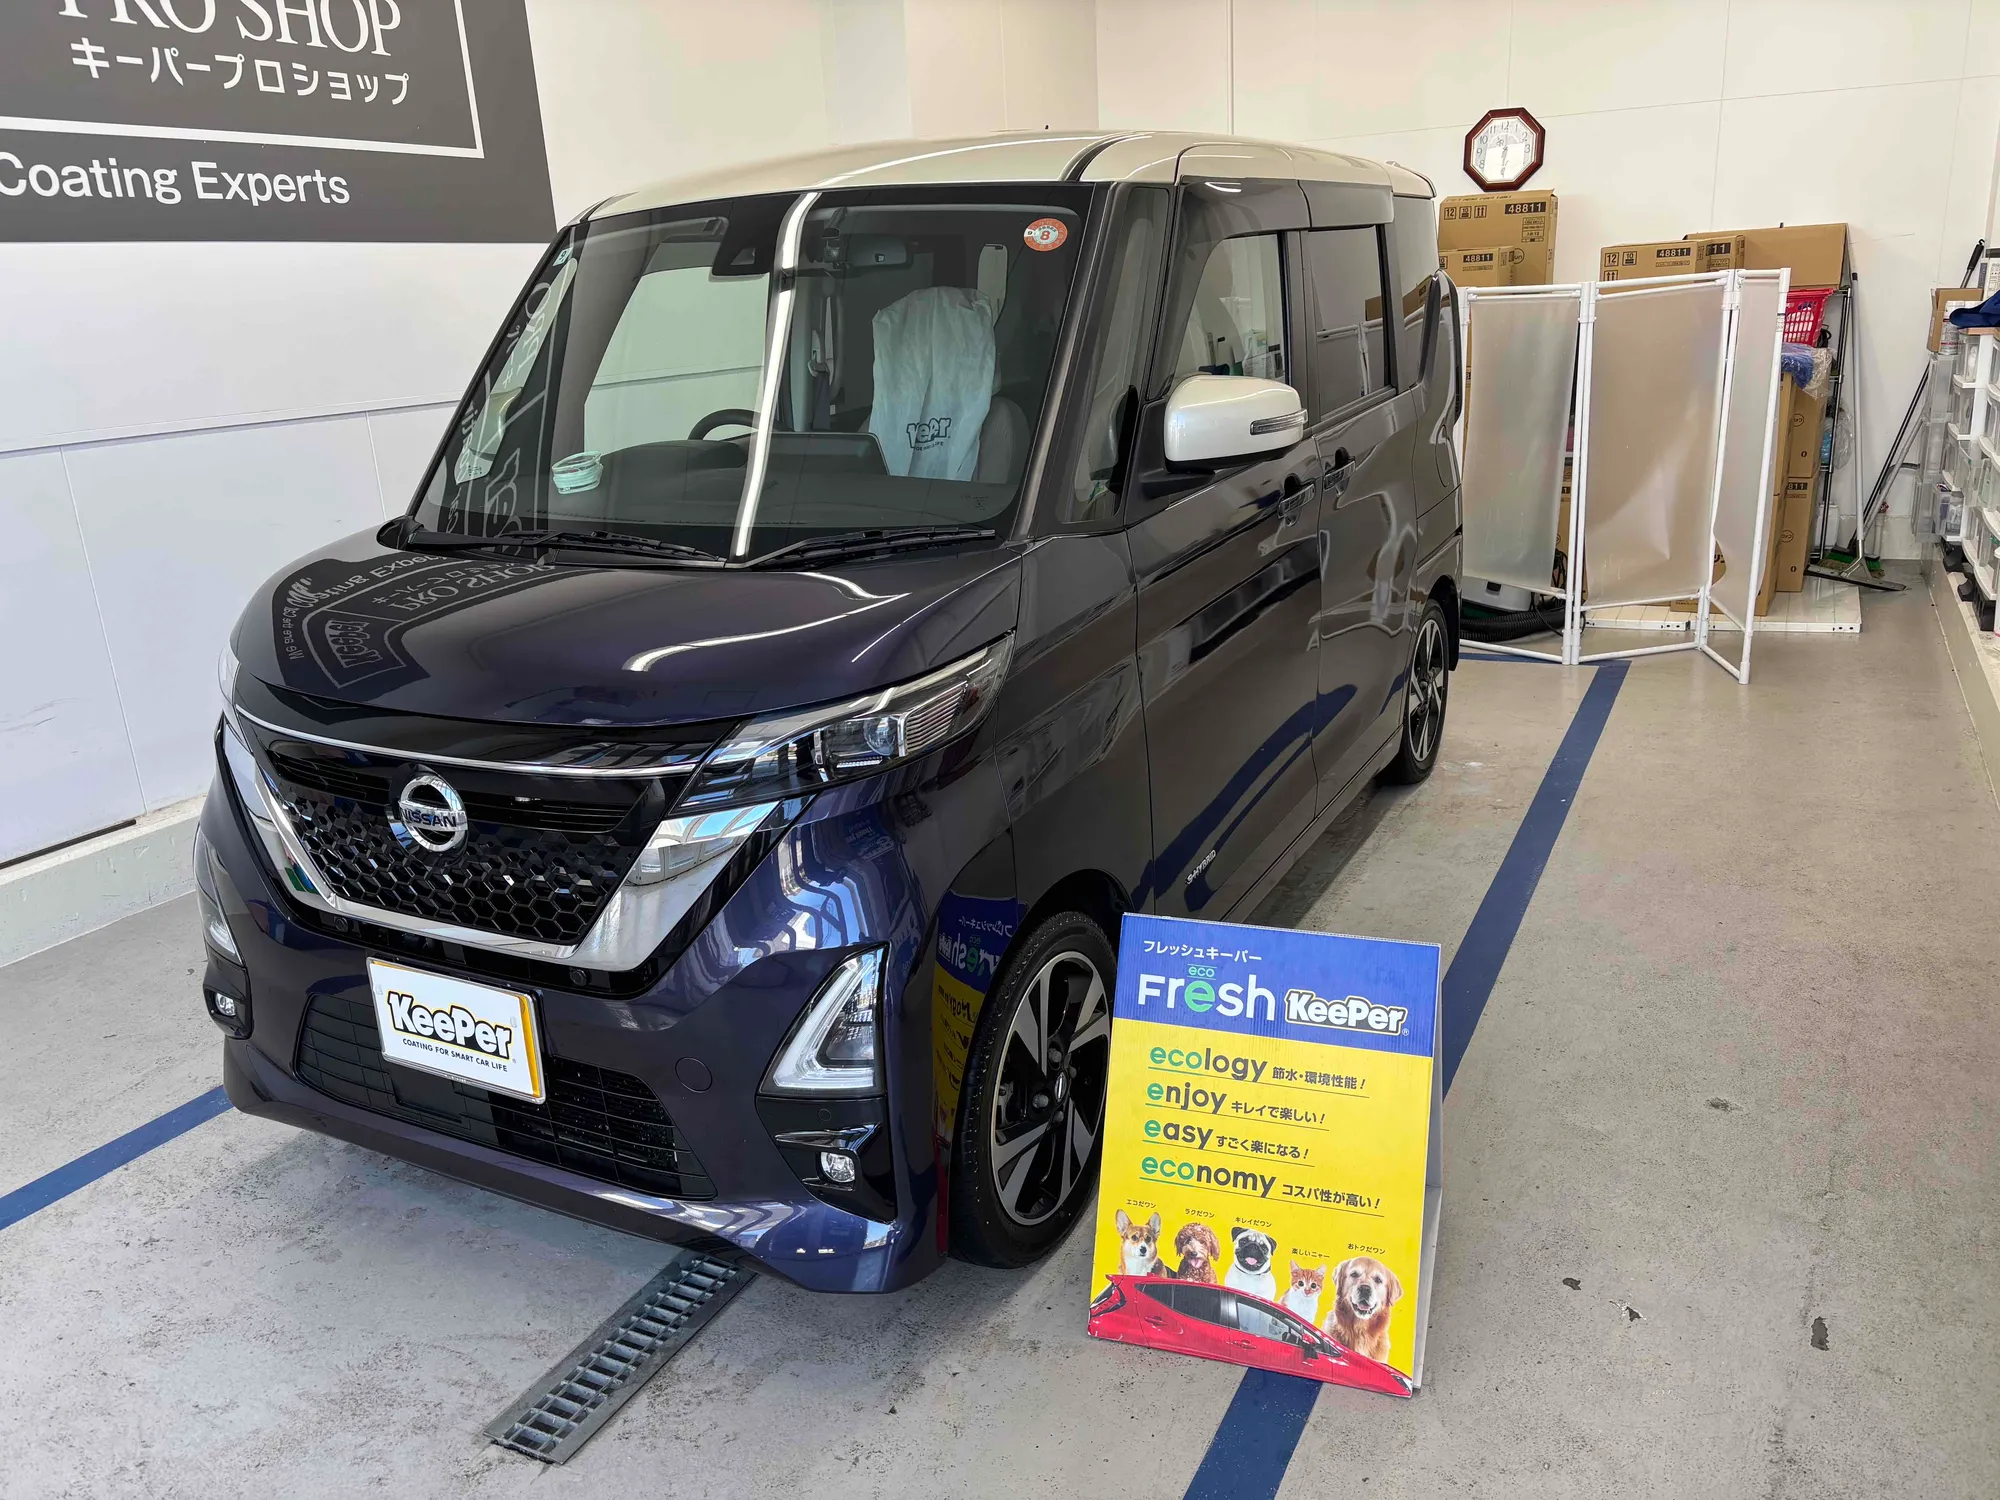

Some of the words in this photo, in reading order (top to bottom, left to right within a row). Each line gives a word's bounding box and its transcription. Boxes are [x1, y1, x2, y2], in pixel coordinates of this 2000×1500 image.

[236, 0, 401, 56] SHOP
[70, 37, 409, 105] キーパープロショップ
[0, 151, 182, 204] Coating
[191, 160, 351, 207] Experts
[1446, 208, 1455, 218] 12
[1508, 203, 1542, 214] 48811
[1040, 230, 1051, 241] 8
[1465, 254, 1490, 263] 48811
[1606, 253, 1617, 265] 12
[1659, 248, 1688, 258] 48811
[402, 808, 457, 828] NISSAN
[1144, 940, 1262, 963] フレッシュキーパー
[1188, 965, 1215, 978] eco
[1138, 974, 1276, 1021] Fresh
[1287, 990, 1407, 1034] KeePer
[388, 991, 512, 1060] KeePer
[402, 1038, 433, 1052] COATING
[435, 1046, 449, 1056] FOR
[451, 1050, 473, 1063] SMART
[475, 1058, 490, 1067] CAR
[491, 1061, 508, 1072] LIFE
[1150, 1046, 1268, 1082] ecology
[1147, 1082, 1227, 1115] enjoy
[1231, 1101, 1326, 1125] キレイで楽しい！
[1144, 1119, 1213, 1149] easy
[1216, 1135, 1309, 1159] すごく楽になる！
[1141, 1156, 1276, 1198] economy
[1282, 1183, 1382, 1210] コスパ性が高い！
[1126, 1199, 1157, 1210] エコだワン
[1185, 1208, 1215, 1219] ラクだワン
[1235, 1217, 1272, 1228] キレイだワン
[1291, 1247, 1330, 1260] 楽しいニャー
[1347, 1242, 1386, 1255] おトクだワン
